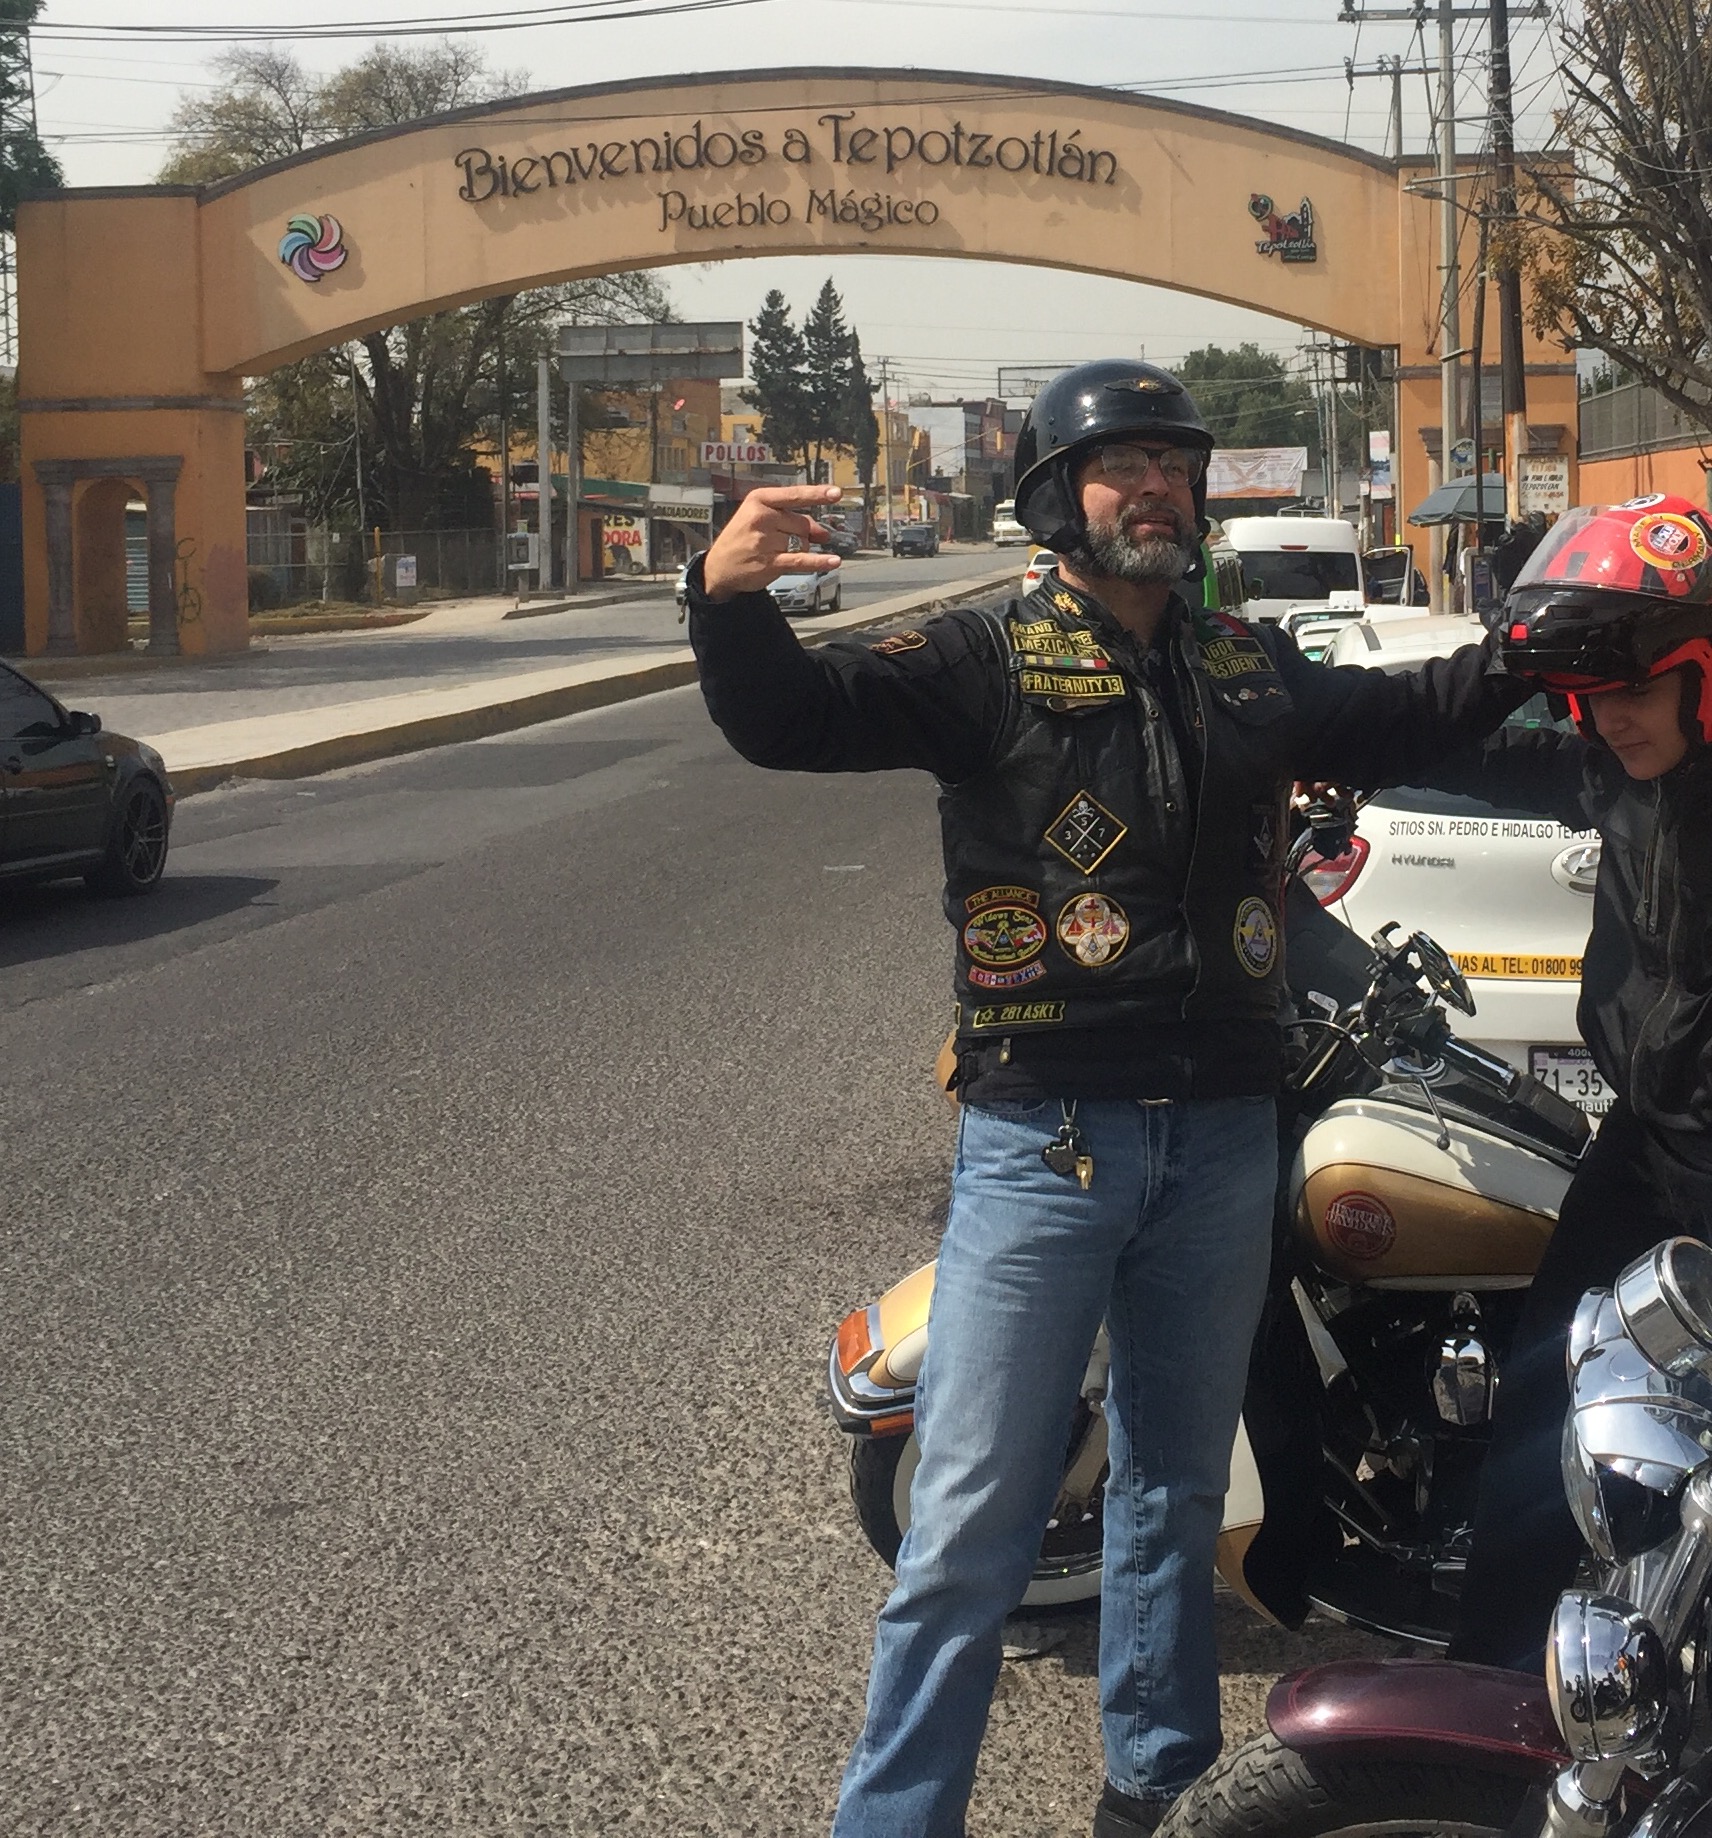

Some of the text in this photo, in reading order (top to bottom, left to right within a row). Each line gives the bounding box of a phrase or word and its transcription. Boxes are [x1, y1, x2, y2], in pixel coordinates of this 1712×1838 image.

[455, 110, 1118, 202] Bienvenidos a Tepotzotlán
[656, 189, 939, 232] Pueblo Mágico
[705, 444, 766, 462] POLLOS
[656, 505, 710, 520] RADIADORES
[1020, 637, 1073, 656] MEXICO
[1023, 673, 1120, 693] FRATERNITY 13
[1080, 816, 1088, 827] 5
[1389, 820, 1425, 836] SITIOS
[1427, 820, 1446, 836] SN.
[1449, 821, 1488, 836] PEDRO
[1491, 822, 1499, 836] E
[1501, 822, 1553, 838] HIDALGO
[1064, 830, 1072, 840] 3
[1098, 827, 1106, 838] 7
[1450, 955, 1478, 973] JAS
[1481, 956, 1498, 973] AL
[1501, 957, 1529, 974] TEL:
[1531, 958, 1566, 975] 01800
